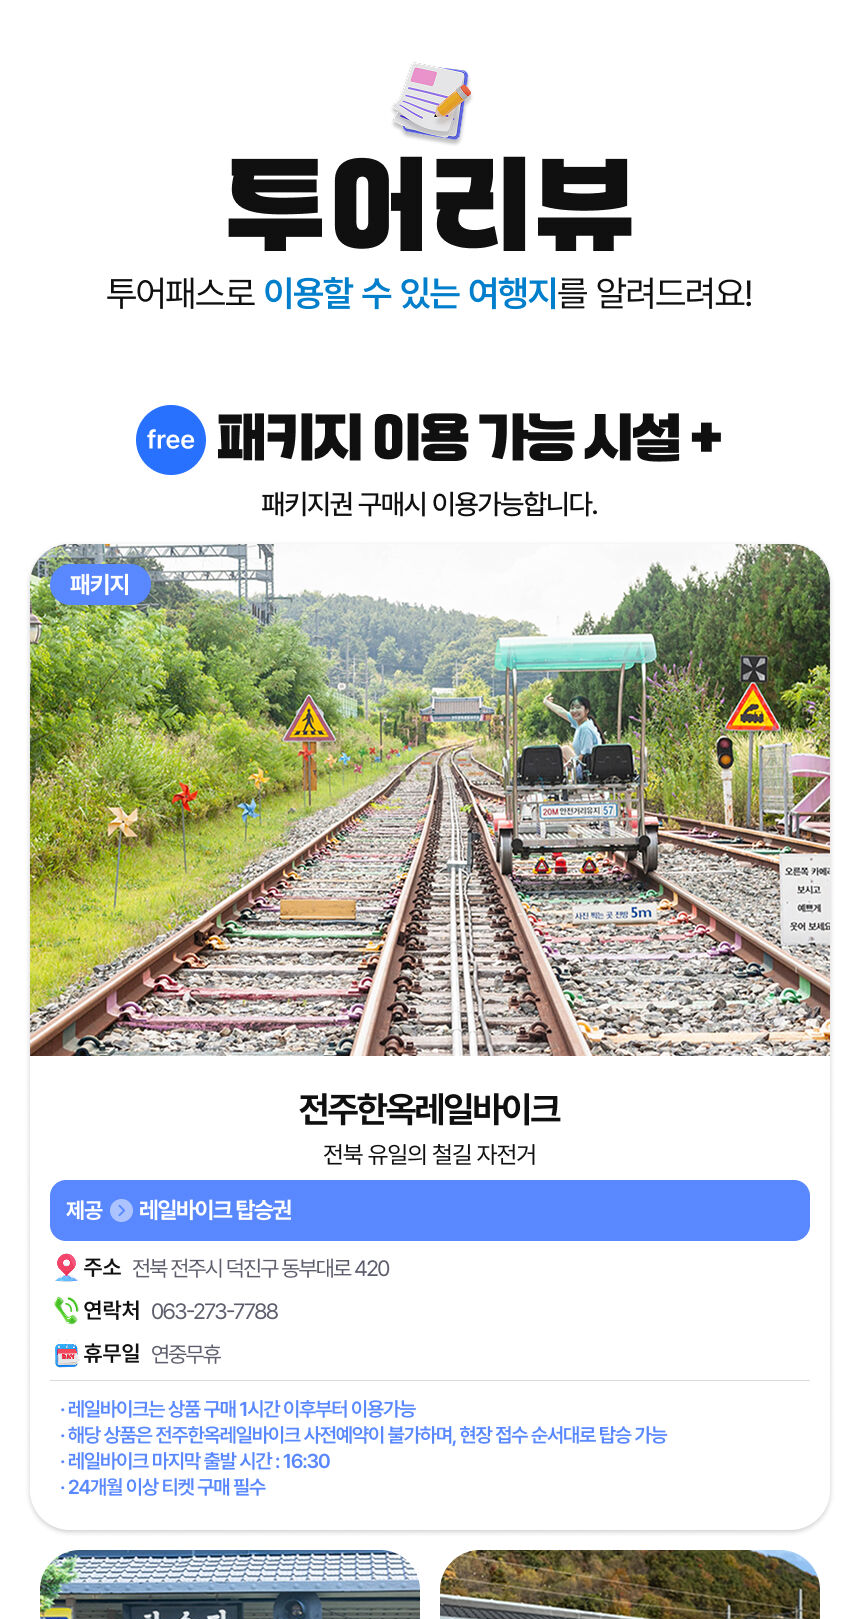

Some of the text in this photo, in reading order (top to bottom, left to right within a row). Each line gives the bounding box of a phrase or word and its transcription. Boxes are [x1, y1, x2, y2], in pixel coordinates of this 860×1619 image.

[543, 805, 614, 816] 20M 안전거리유지 57
[785, 866, 809, 876] 오른쪽
[797, 885, 821, 894] 보시고
[631, 906, 652, 918] 5m
[790, 922, 806, 932] 웃어
